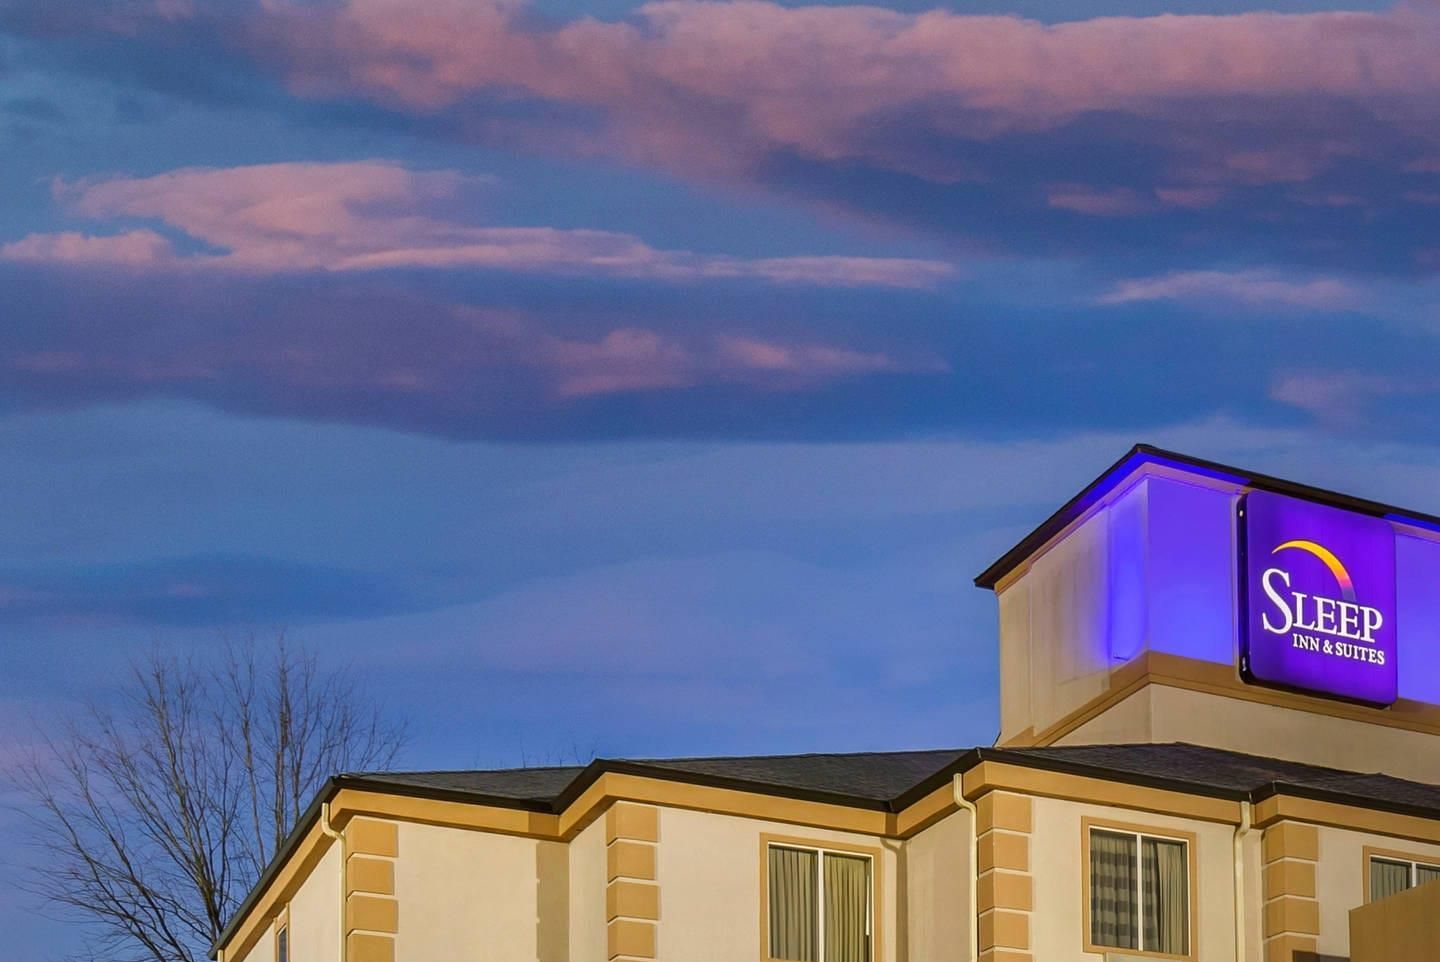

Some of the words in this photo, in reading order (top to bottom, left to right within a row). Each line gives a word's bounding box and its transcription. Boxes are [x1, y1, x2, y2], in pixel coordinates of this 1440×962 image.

[1262, 568, 1383, 643] SLEEP
[1293, 633, 1320, 652] INN
[1322, 639, 1333, 655] &
[1335, 642, 1385, 665] SUITES
